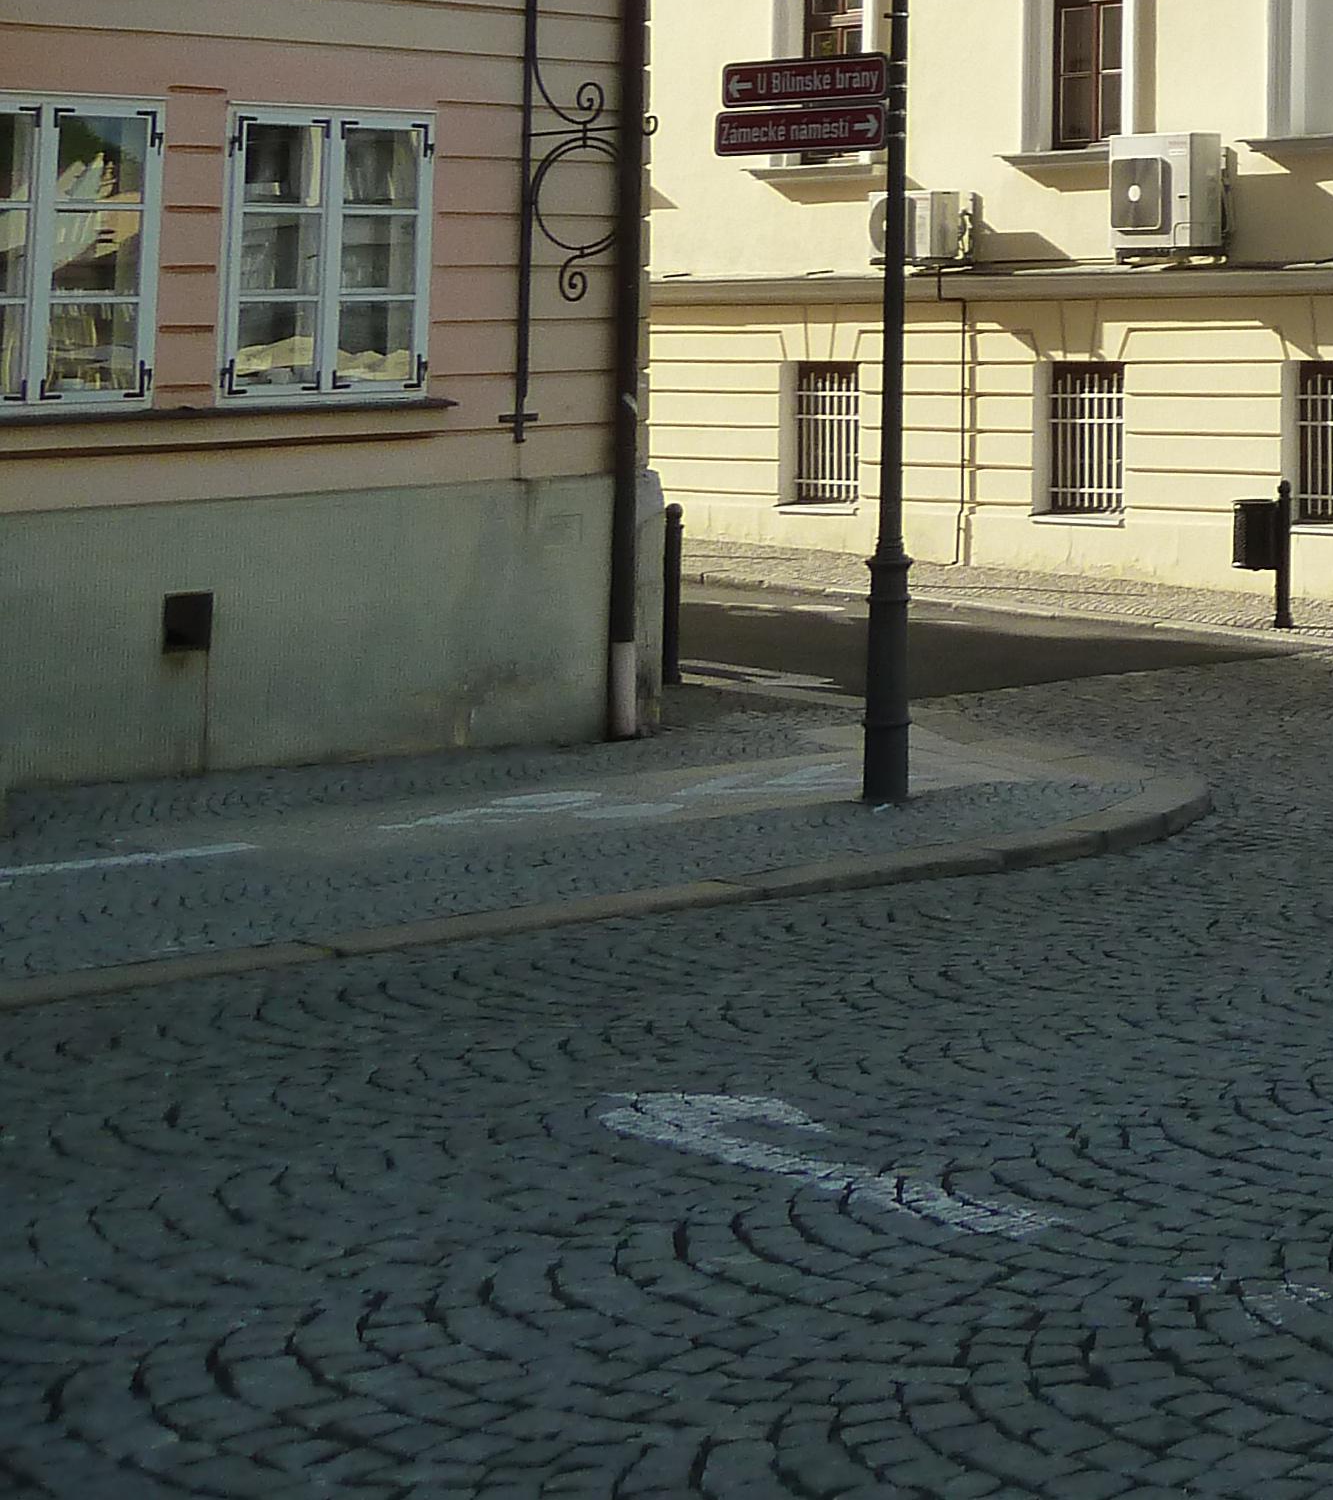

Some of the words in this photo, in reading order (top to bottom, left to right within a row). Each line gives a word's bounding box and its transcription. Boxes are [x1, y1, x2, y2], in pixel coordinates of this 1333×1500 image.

[757, 73, 766, 94] U
[836, 67, 879, 92] brány
[721, 122, 787, 145] Zámecké
[790, 116, 849, 140] náměstí
